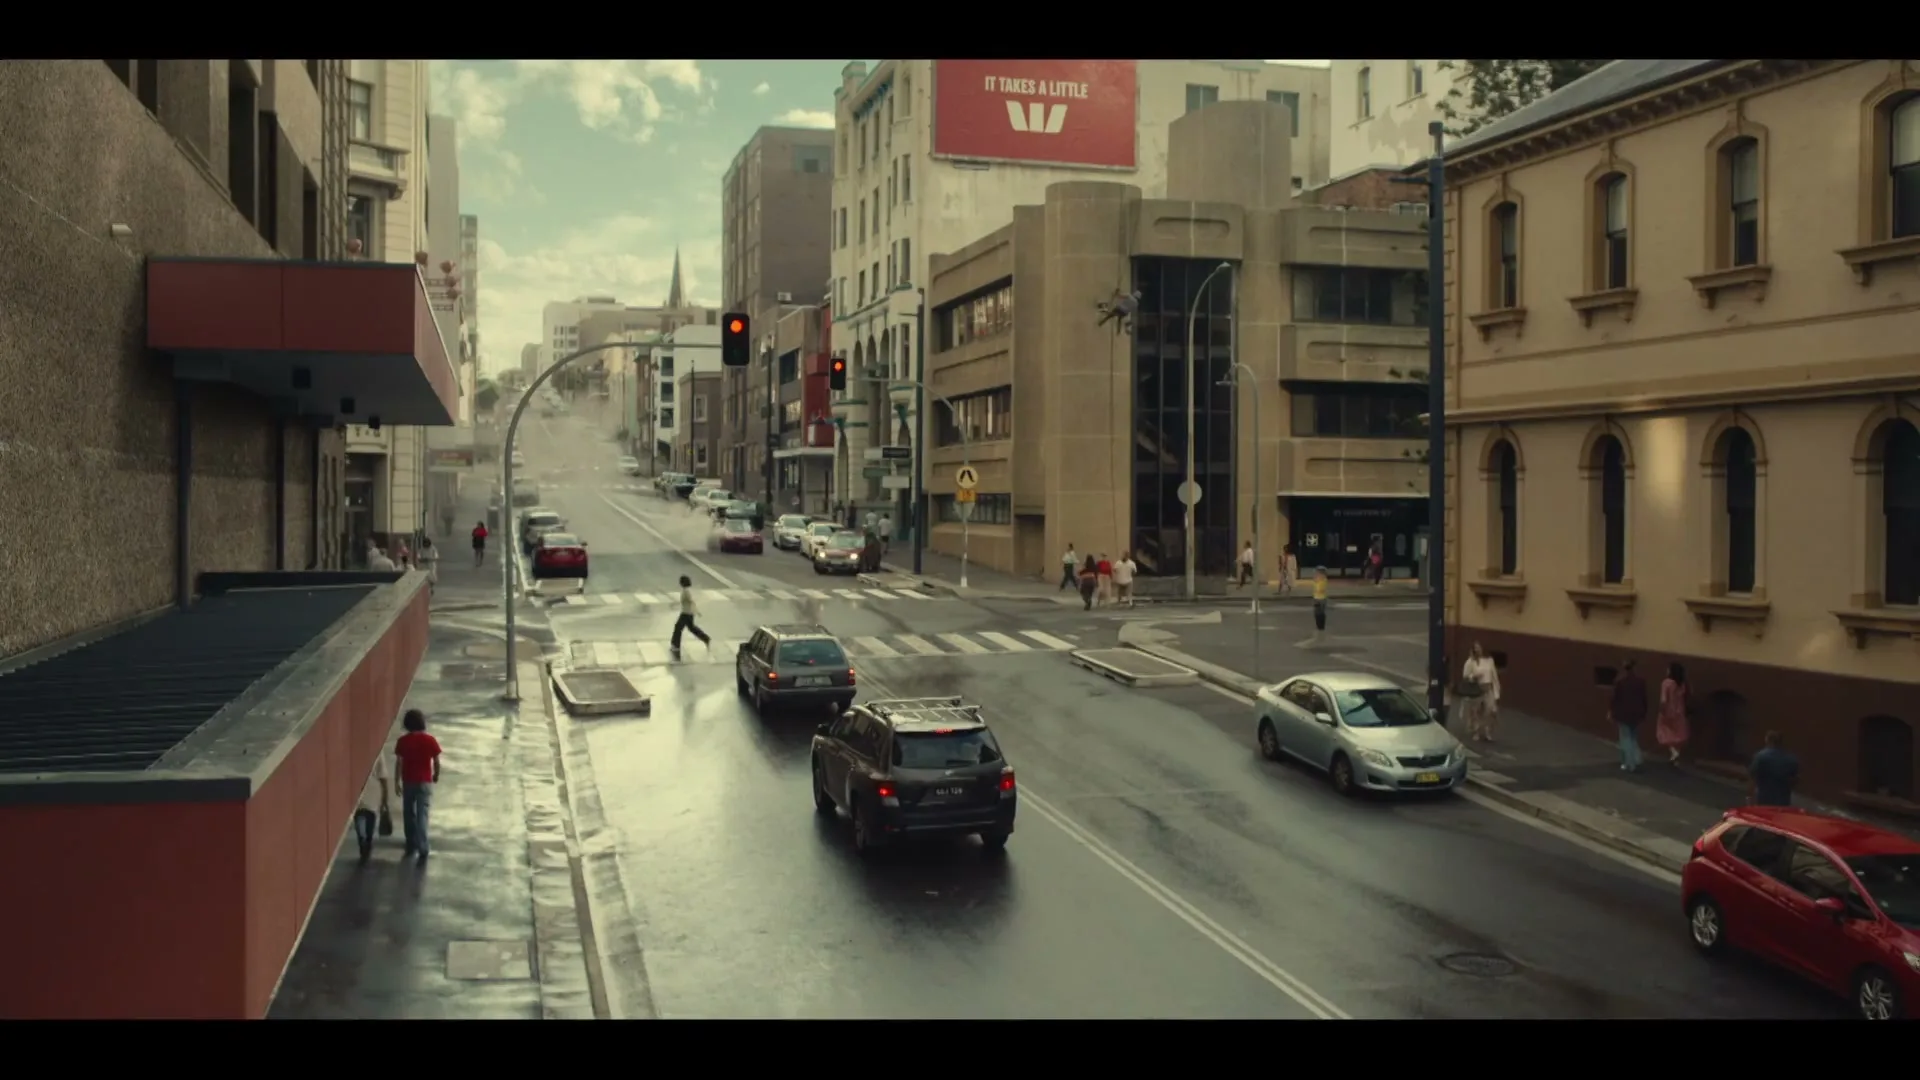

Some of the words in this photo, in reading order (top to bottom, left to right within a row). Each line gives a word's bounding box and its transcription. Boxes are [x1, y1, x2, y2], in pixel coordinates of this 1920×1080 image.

[985, 75, 997, 92] IT
[999, 77, 1036, 96] TAKES
[1038, 79, 1047, 96] A
[1049, 80, 1089, 99] LITTLE
